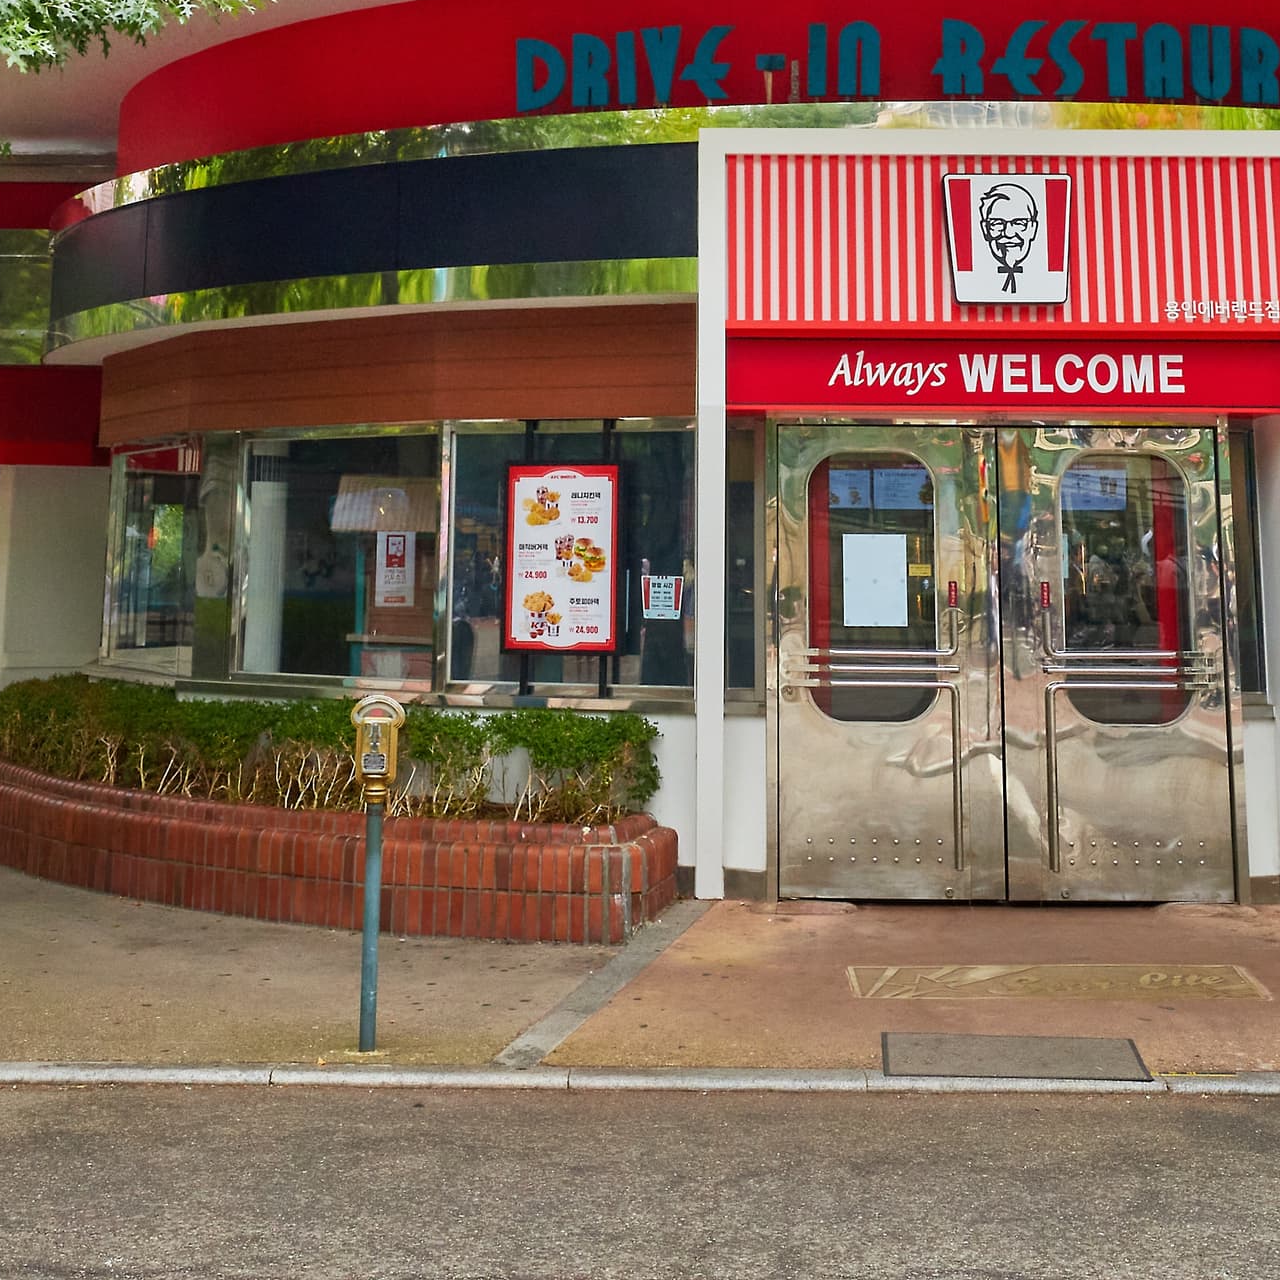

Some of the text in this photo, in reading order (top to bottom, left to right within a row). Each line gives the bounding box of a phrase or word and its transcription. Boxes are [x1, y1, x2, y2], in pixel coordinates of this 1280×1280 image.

[1164, 300, 1280, 320] 용인에버랜드점
[827, 351, 1186, 397] Always WELCOME
